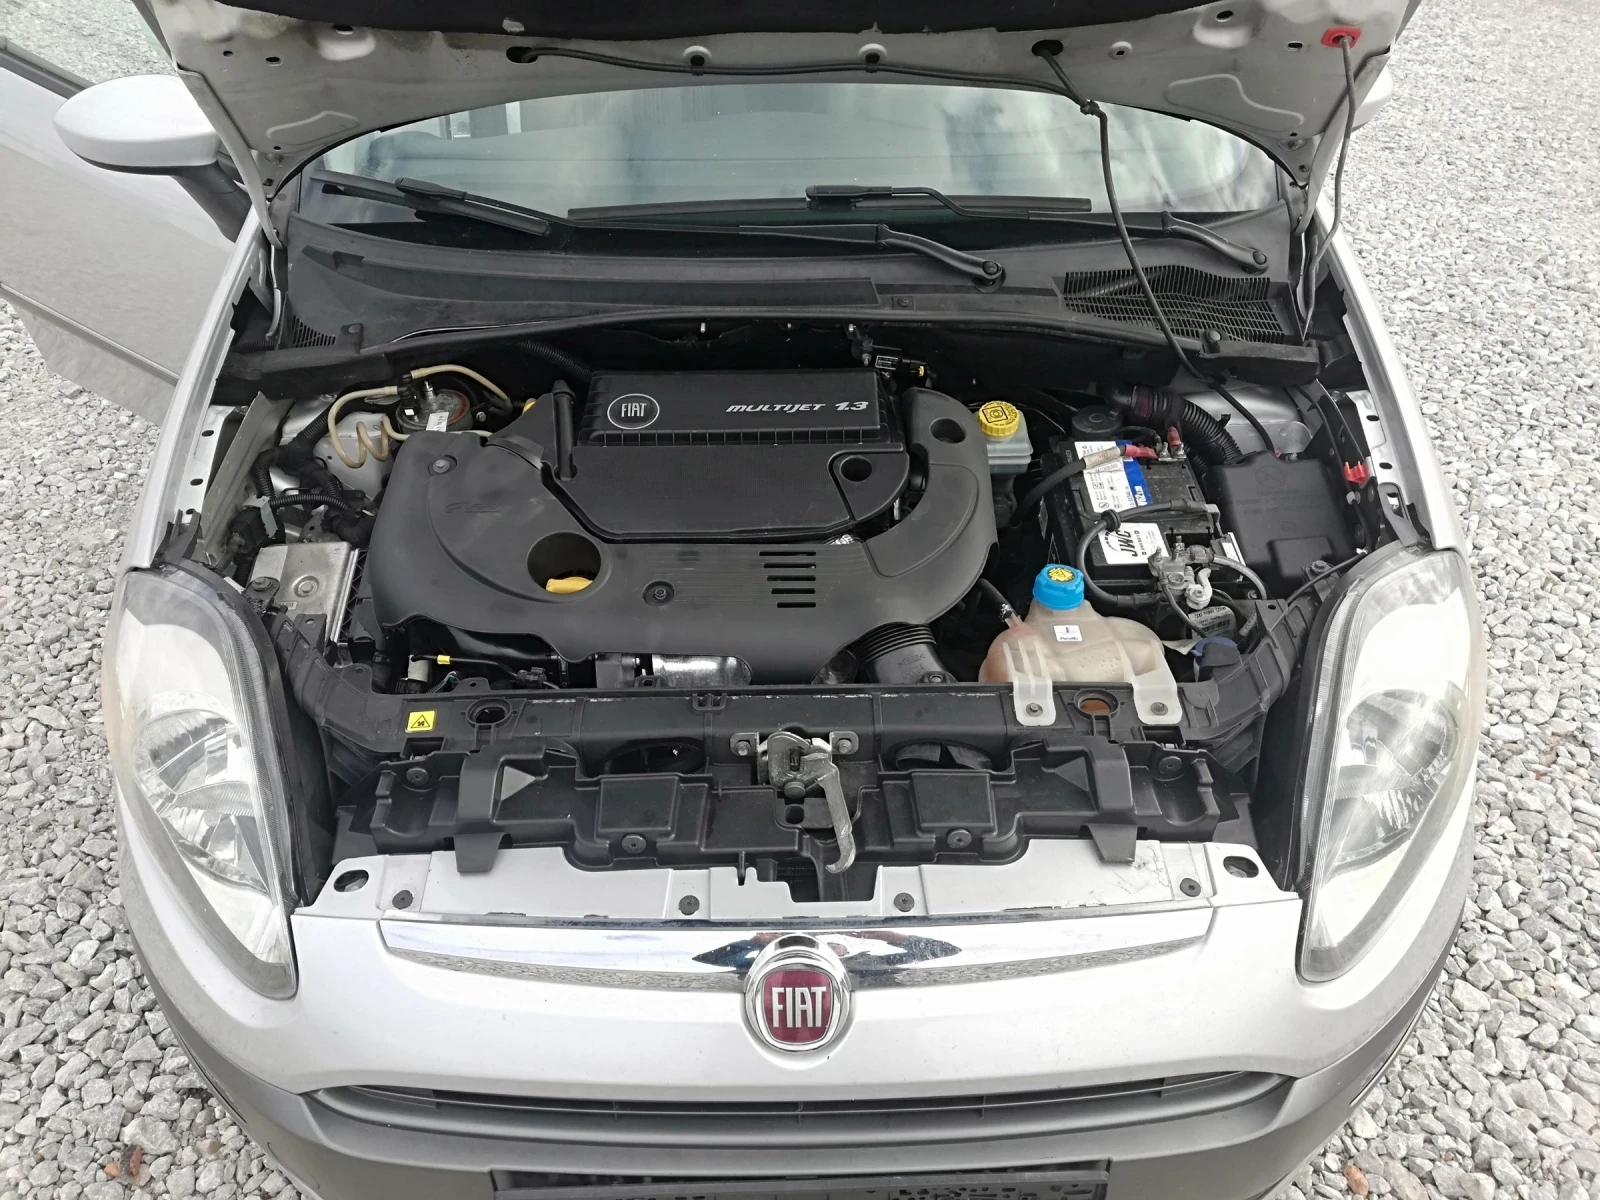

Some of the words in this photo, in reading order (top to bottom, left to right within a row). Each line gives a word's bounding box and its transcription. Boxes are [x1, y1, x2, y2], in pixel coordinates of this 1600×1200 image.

[621, 402, 647, 418] FIAT
[725, 403, 826, 413] MULTIJET
[835, 401, 869, 411] 1.3
[771, 986, 827, 1028] FIAT
